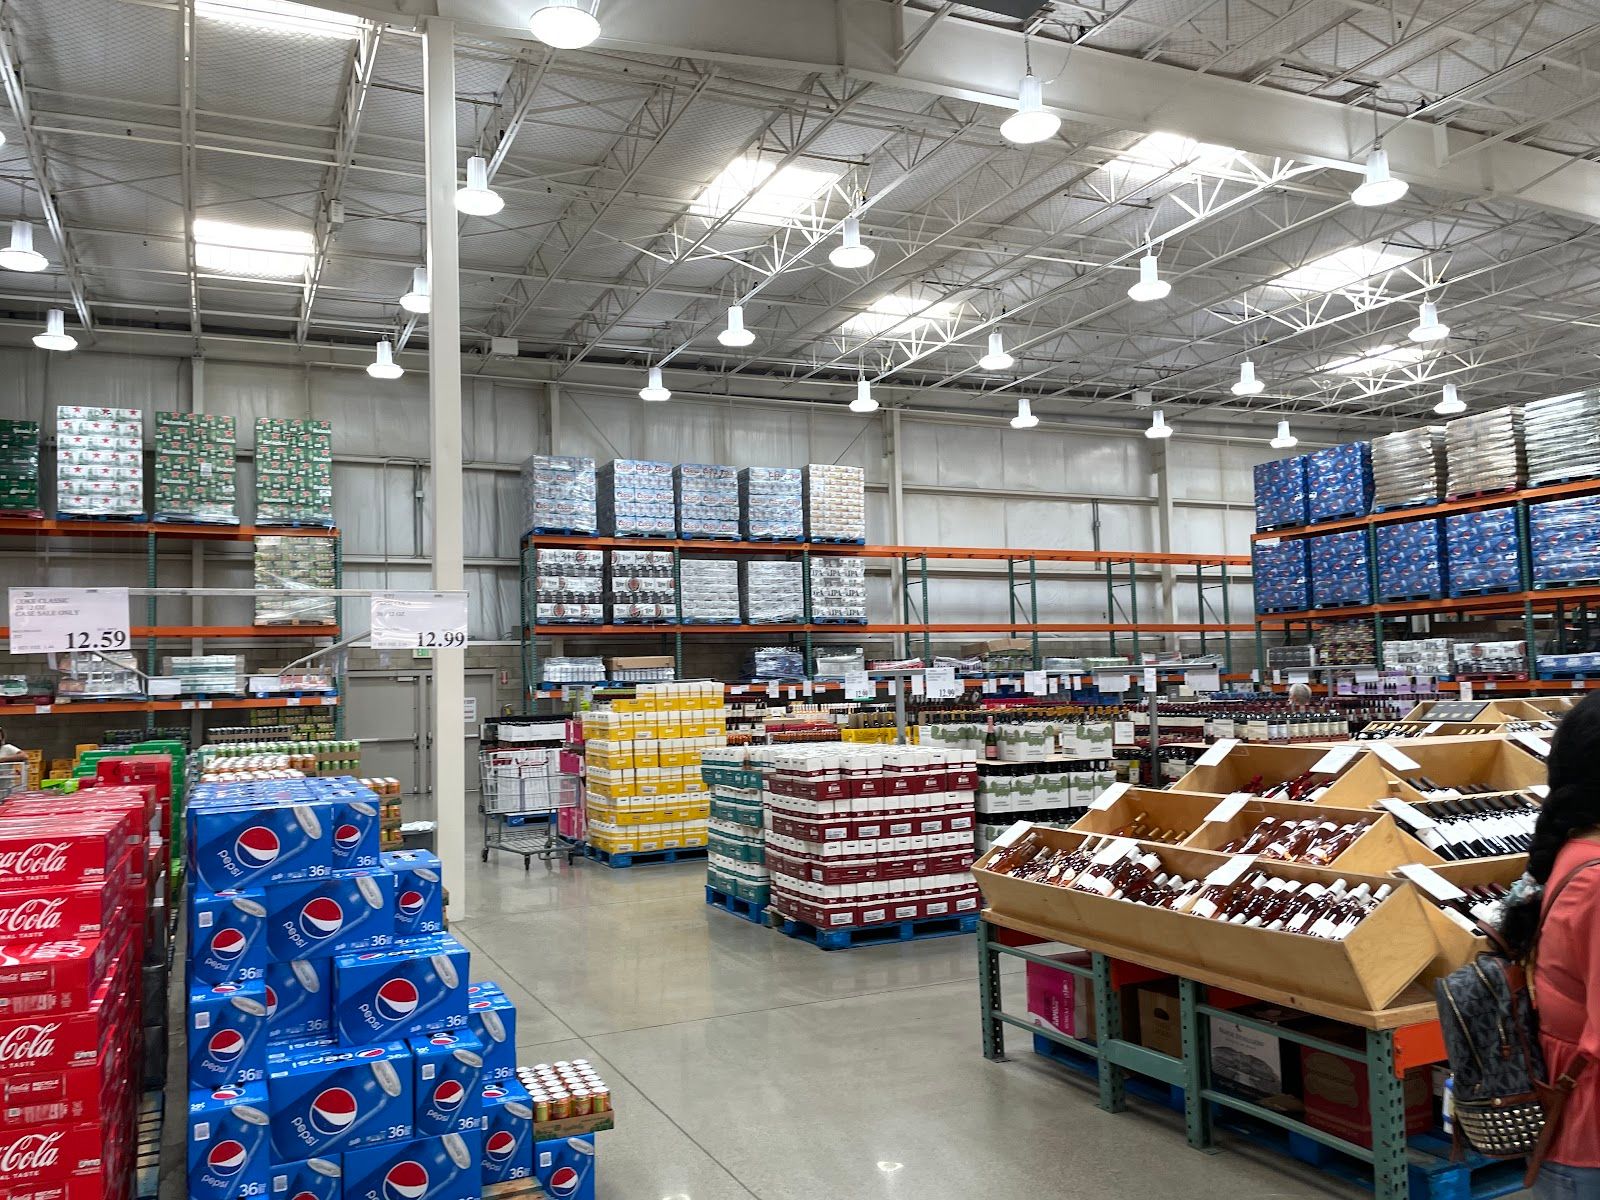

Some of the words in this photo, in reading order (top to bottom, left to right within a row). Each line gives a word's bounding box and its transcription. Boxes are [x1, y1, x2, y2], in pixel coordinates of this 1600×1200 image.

[65, 630, 126, 650] 12.59
[416, 631, 465, 647] 12.99
[217, 849, 244, 878] pepsi
[357, 856, 372, 866] 36
[309, 865, 326, 877] 36
[420, 922, 435, 932] 36
[282, 921, 309, 949] pepsi
[371, 935, 386, 947] 36
[204, 958, 231, 972] pepsi
[238, 968, 256, 981] 36
[358, 1003, 384, 1031] pepsi
[446, 1015, 461, 1027] 36
[307, 1019, 322, 1032] 36
[8, 1060, 36, 1069] TASTE
[201, 1059, 228, 1073] pepsi
[237, 1069, 255, 1082] 36
[494, 1067, 509, 1079] 36
[426, 1109, 450, 1122] pepsi
[458, 1117, 475, 1130] 36
[291, 1116, 320, 1147] pepsi
[388, 1125, 404, 1139] 36
[13, 1170, 40, 1179] TASTE
[509, 1166, 524, 1179] 36
[201, 1173, 230, 1188] pepsi
[239, 1182, 259, 1198] 36
